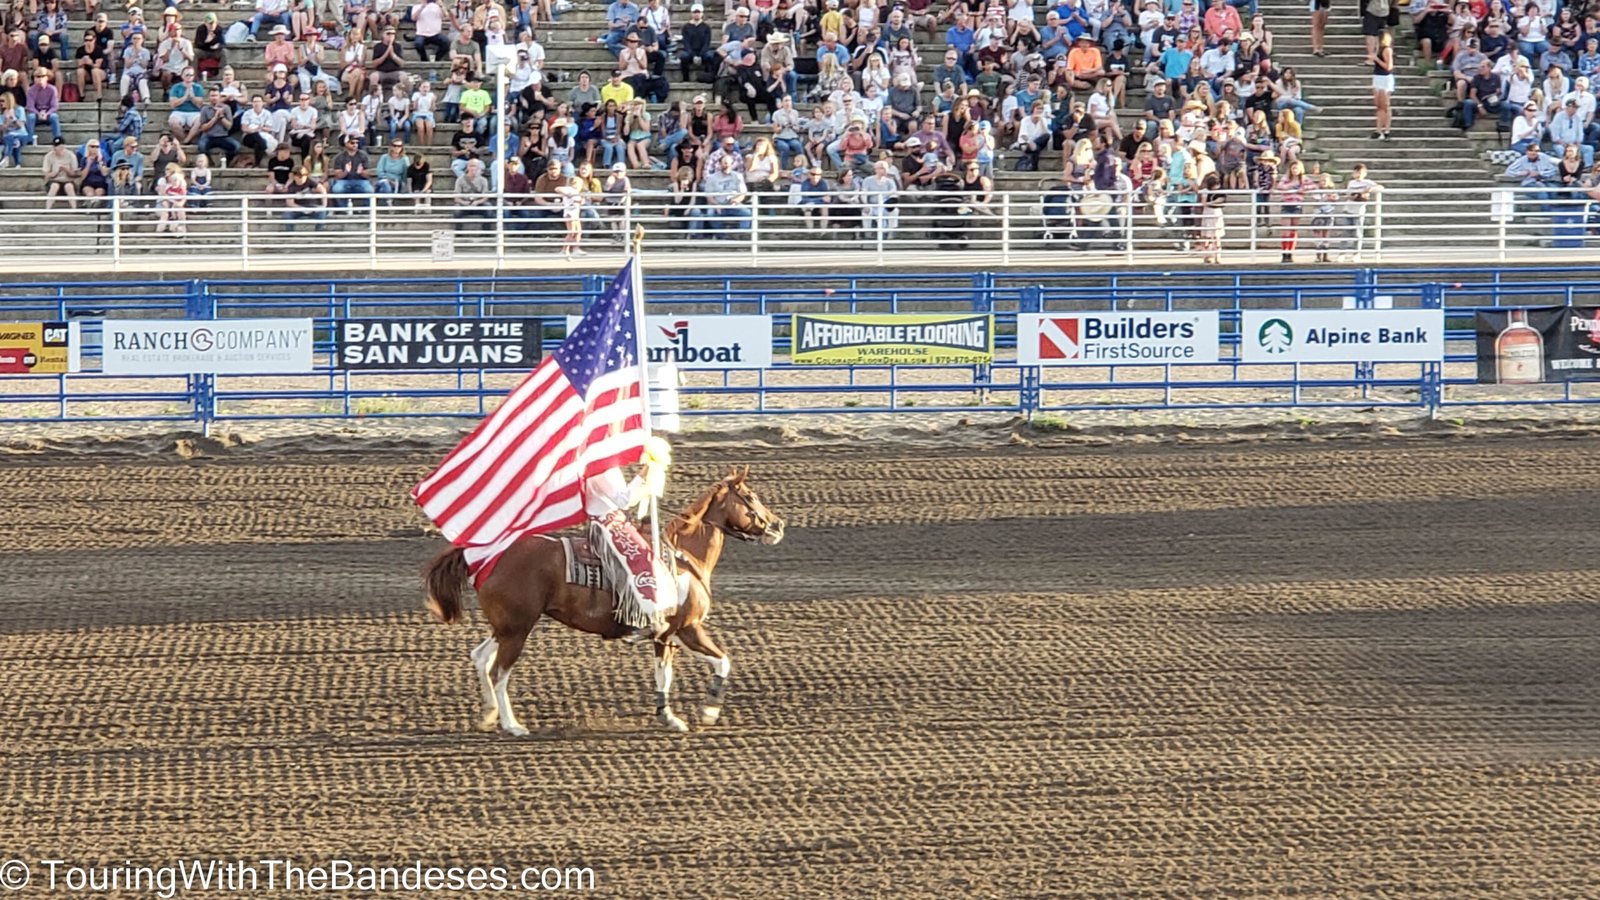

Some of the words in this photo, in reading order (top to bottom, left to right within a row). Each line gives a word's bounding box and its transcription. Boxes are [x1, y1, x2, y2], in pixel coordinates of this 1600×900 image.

[44, 328, 67, 342] CAT
[344, 323, 436, 342] BANK
[443, 323, 473, 336] OF
[479, 323, 523, 336] THE
[801, 321, 905, 349] AFFORDABLE
[906, 320, 985, 348] FLOORING
[1085, 318, 1193, 339] Builders
[1305, 328, 1371, 347] Alpine
[1378, 327, 1427, 344] Bank
[113, 332, 188, 349] RANCH
[215, 330, 302, 350] COMPANY
[343, 345, 408, 363] SAN
[416, 345, 523, 363] JUANS
[1084, 343, 1194, 359] FirstSource
